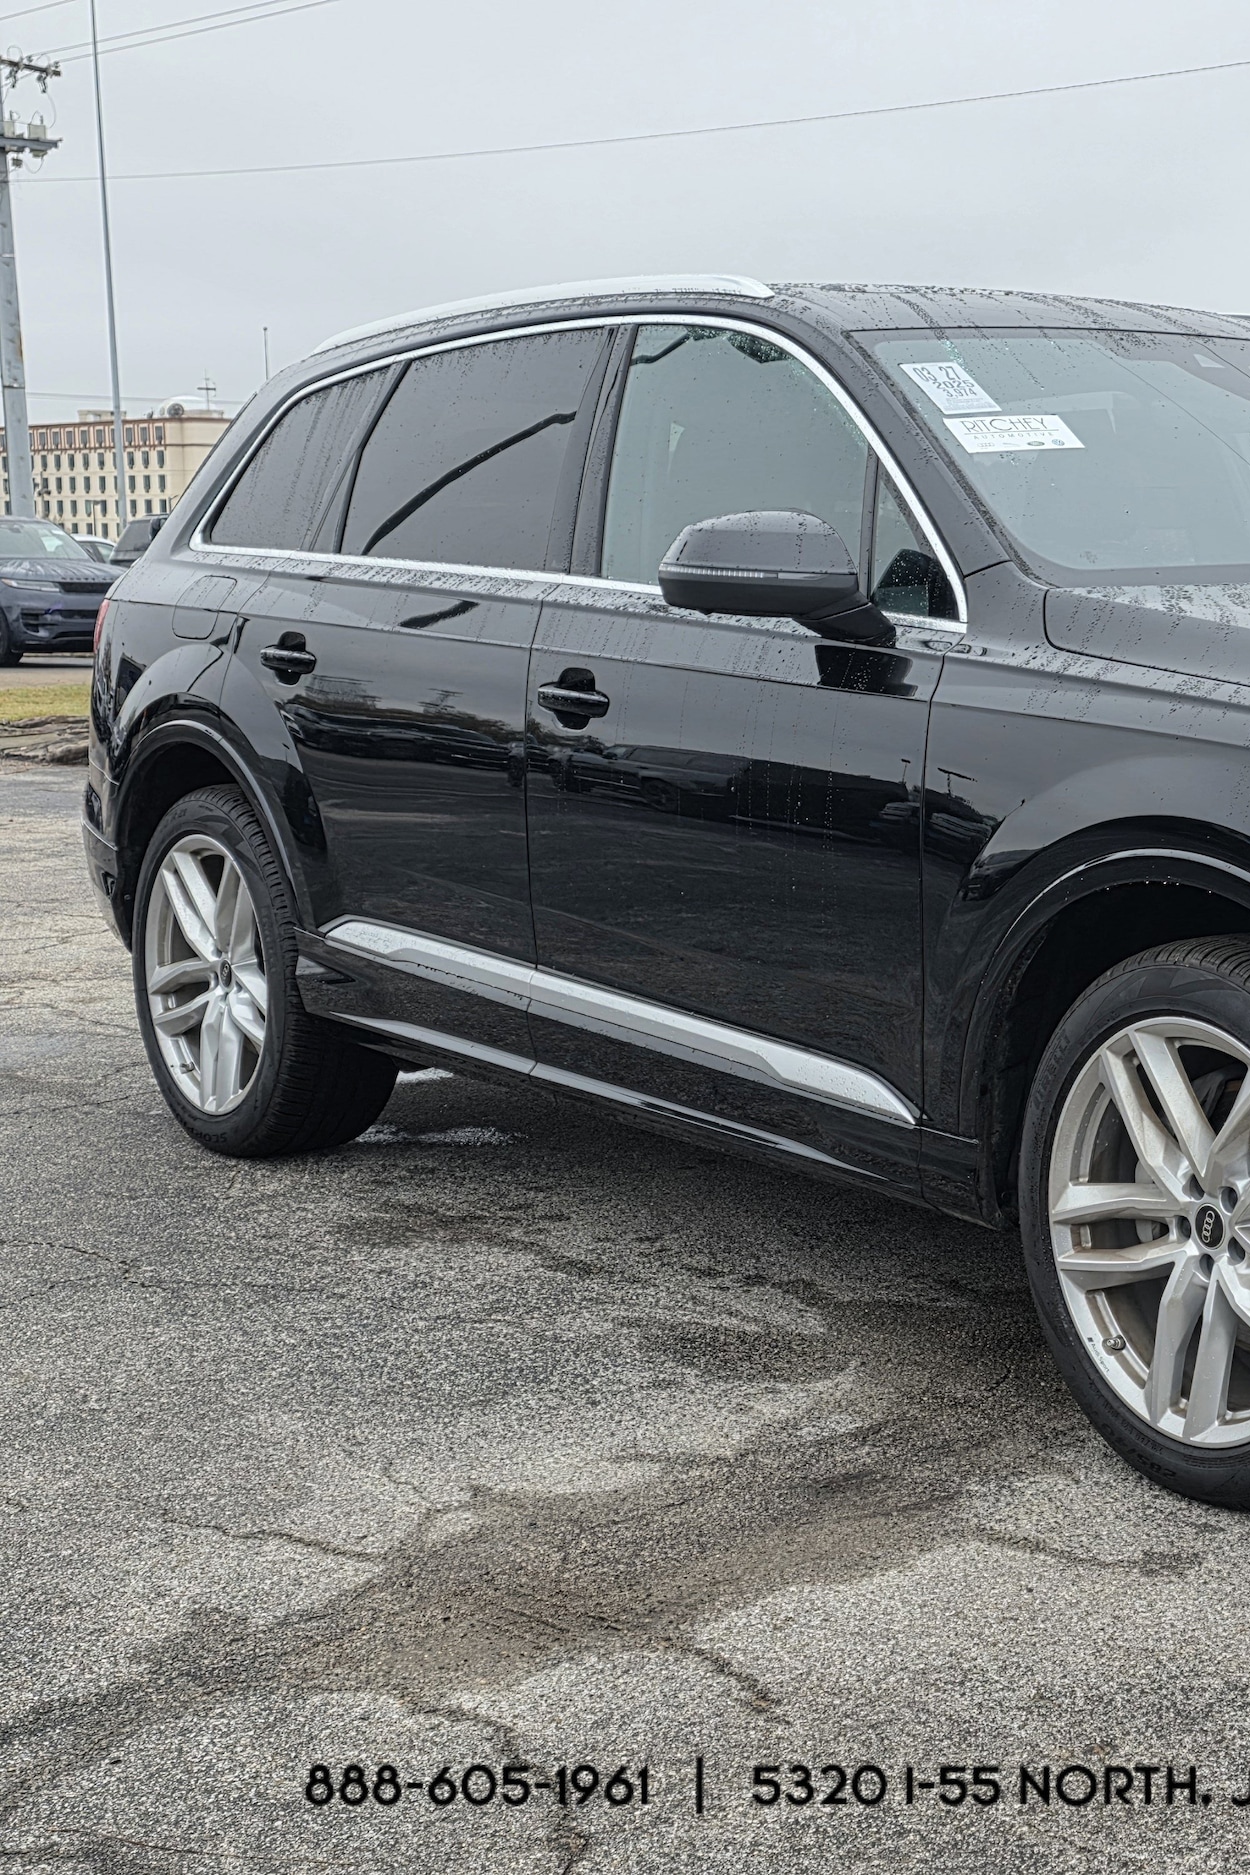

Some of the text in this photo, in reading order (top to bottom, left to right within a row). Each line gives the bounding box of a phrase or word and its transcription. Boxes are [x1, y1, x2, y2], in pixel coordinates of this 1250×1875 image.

[913, 366, 961, 382] 03 27
[933, 380, 975, 389] 2025
[960, 418, 1047, 432] RITCHEY
[973, 432, 1054, 440] AUTOMOTIVE
